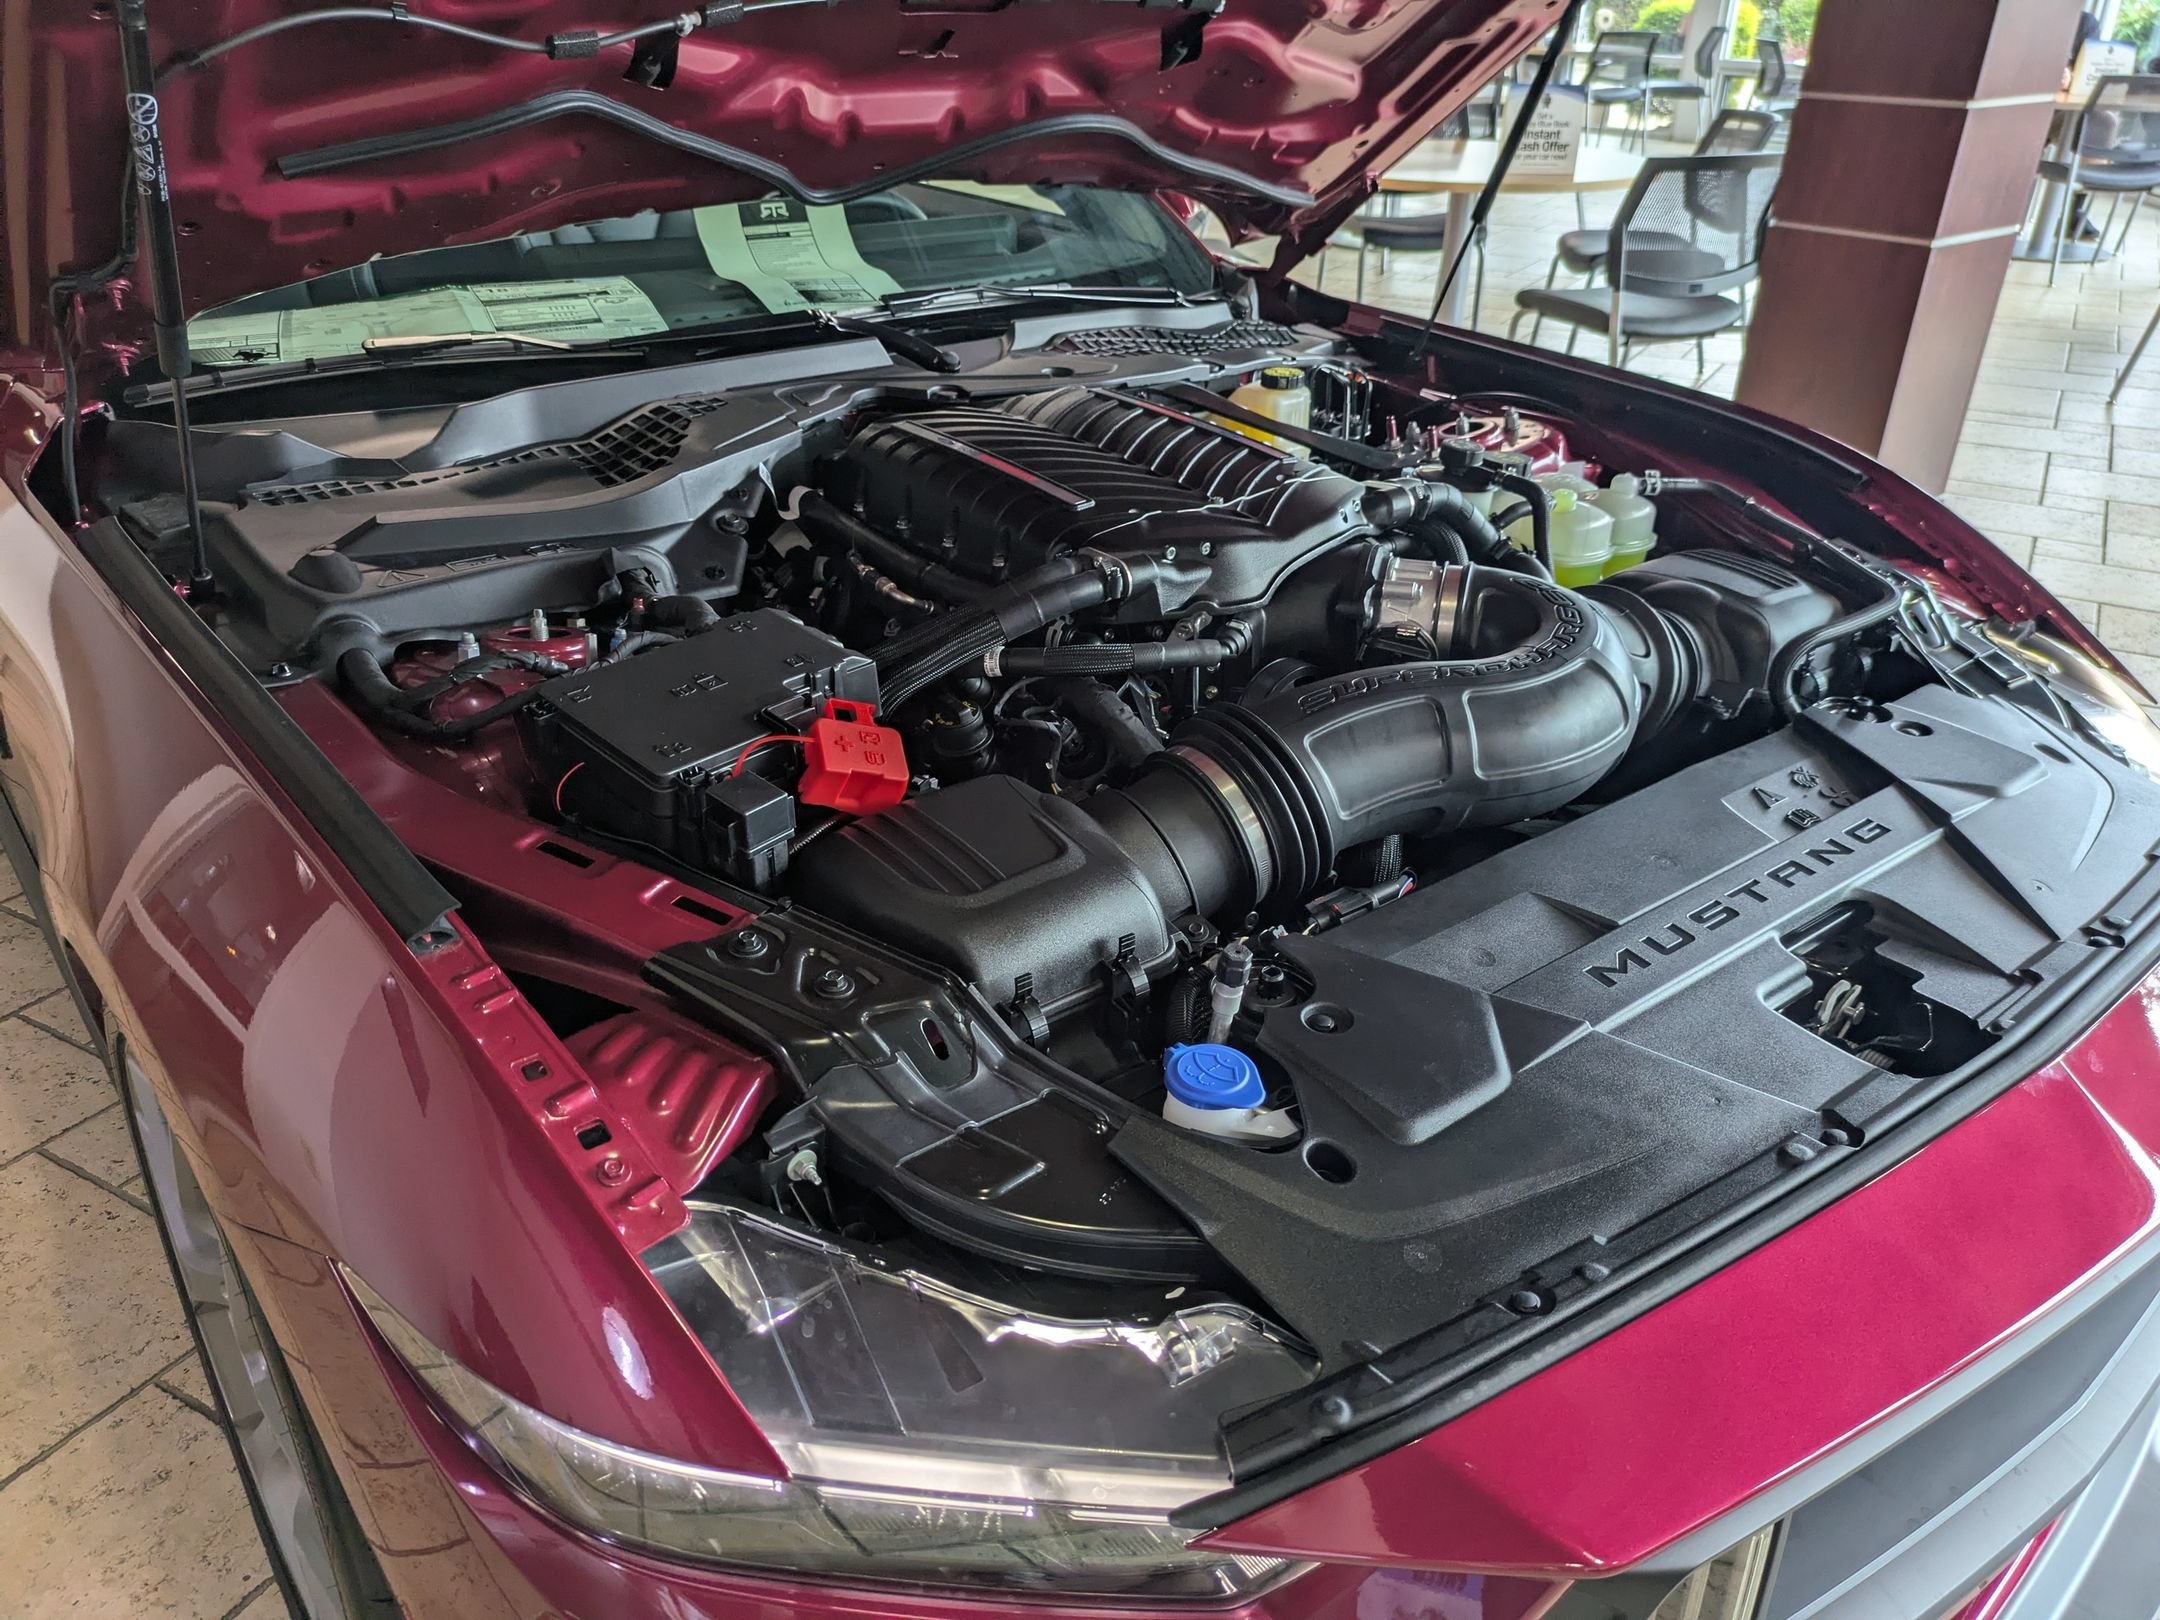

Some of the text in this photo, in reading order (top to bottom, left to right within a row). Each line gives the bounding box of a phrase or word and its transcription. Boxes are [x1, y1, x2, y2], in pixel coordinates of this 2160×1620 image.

[1517, 141, 1569, 152] ash Offer
[1582, 818, 1893, 988] MUSTANG
